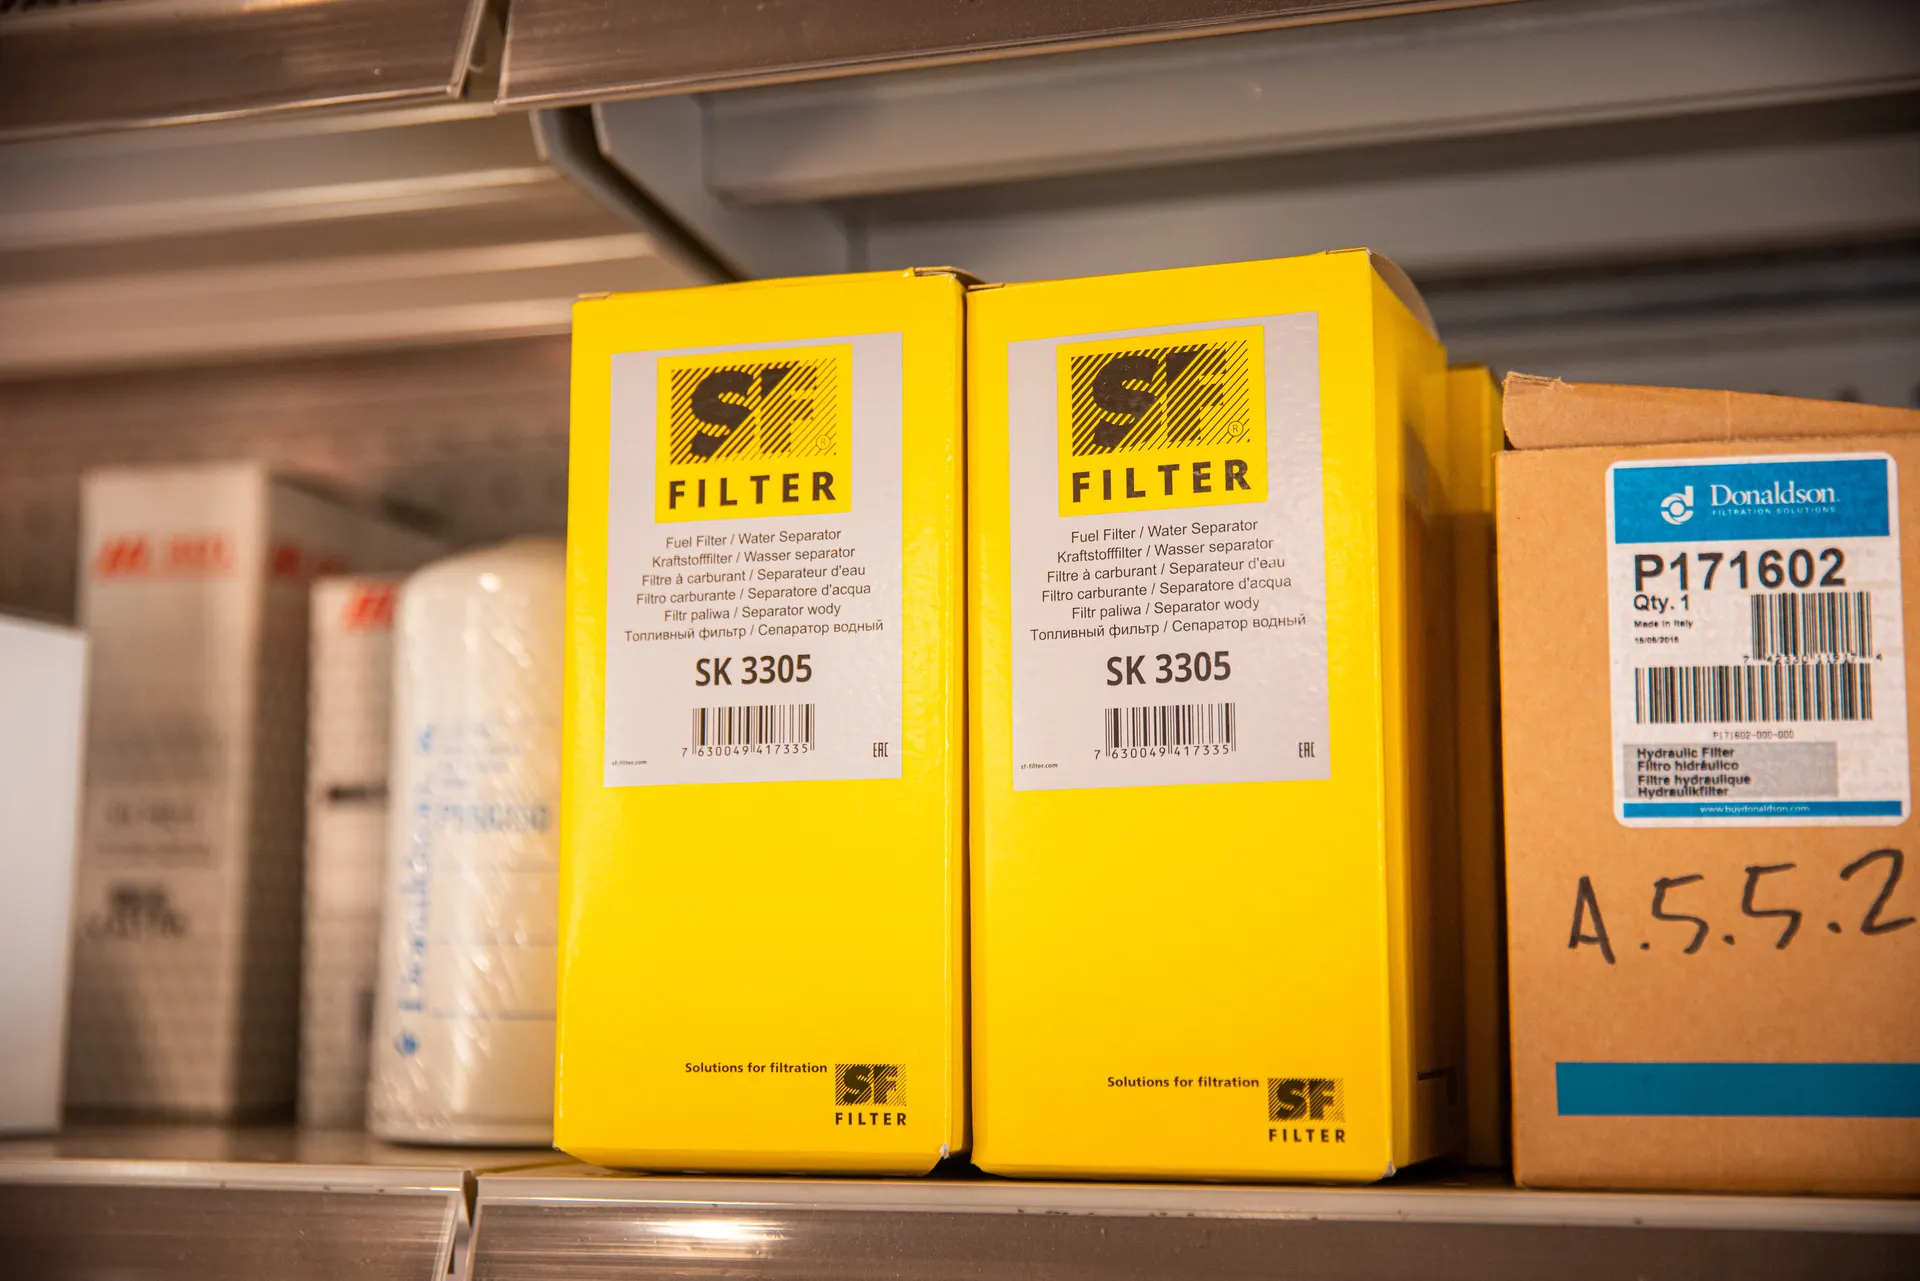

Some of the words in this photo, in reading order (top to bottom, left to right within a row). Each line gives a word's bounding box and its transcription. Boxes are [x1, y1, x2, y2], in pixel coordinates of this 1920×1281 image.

[1092, 348, 1228, 449] SF
[689, 366, 818, 459] SF
[669, 471, 836, 509] FILTER
[1072, 458, 1251, 503] FILTER
[1710, 481, 1835, 506] Donaldson
[1712, 508, 1771, 516] FILTRATION
[1777, 506, 1836, 515] SOLUTIONS
[666, 536, 693, 548] Fuel
[696, 534, 726, 547] Filter
[739, 531, 776, 544] Water
[779, 528, 841, 545] Separator
[1071, 529, 1099, 543] Fuel
[1103, 527, 1136, 541] Filter
[1148, 523, 1187, 538] Water
[1191, 519, 1259, 537] Separator
[652, 552, 733, 567] Kraftstofffilter
[744, 549, 791, 562] Wasser
[795, 546, 855, 563] separator
[1057, 547, 1143, 563] Kraftstofffilter
[1155, 542, 1205, 556] Wasser
[1209, 538, 1273, 556] separator
[642, 573, 672, 586] Filtre
[676, 572, 683, 585] à
[687, 570, 746, 584] carburant
[757, 566, 828, 582] Separateur
[831, 564, 865, 577] d'eau
[1047, 569, 1078, 581] Filtre
[1082, 568, 1091, 580] à
[1094, 564, 1158, 579] carburant
[1169, 559, 1244, 577] Separateur
[1248, 557, 1285, 570] d'eau
[1634, 548, 1846, 592] P171602
[636, 591, 666, 605] Filtro
[670, 588, 736, 603] carburante
[748, 586, 818, 602] Separatore
[821, 583, 871, 599] d'acqua
[1042, 589, 1073, 602] Filtro
[1077, 585, 1148, 600] carburante
[1160, 579, 1234, 598] Separatore
[1238, 577, 1292, 594] d'acqua
[664, 609, 687, 621] Filtr
[690, 607, 730, 624] paliwa
[742, 604, 803, 621] Separator
[806, 603, 841, 618] wody
[1072, 607, 1097, 620] Filtr
[1100, 603, 1143, 622] paliwa
[1154, 599, 1221, 618] Separator
[1224, 597, 1260, 614] wody
[1634, 595, 1675, 614] Qty.
[1680, 594, 1689, 610] 1
[624, 626, 695, 642] Топливный
[699, 625, 746, 643] фильтр
[758, 622, 830, 639] Сепаратор
[833, 620, 884, 635] водный
[1030, 625, 1105, 642] Топливный
[1109, 622, 1160, 643] фильтр
[1172, 618, 1249, 637] Сепаратор
[1253, 614, 1306, 631] водный
[1634, 620, 1659, 628] Made
[1674, 619, 1693, 629] Italy
[695, 658, 732, 686] SK
[742, 655, 812, 684] 3305
[1107, 655, 1146, 686] SK
[1156, 651, 1231, 684] 3305
[682, 748, 688, 757] 7
[698, 746, 748, 756] 630049
[756, 744, 808, 754] 417335
[1094, 750, 1100, 760] 7
[1112, 747, 1165, 759] 630049
[1174, 745, 1228, 756] 417335
[1637, 749, 1698, 761] Hydraulic
[1702, 748, 1735, 757] Filter
[1021, 762, 1058, 770] sf-filter.com
[1638, 761, 1671, 771] Filtro
[1675, 760, 1739, 771] hidráulico
[1638, 775, 1671, 785] Filtre
[1674, 774, 1751, 786] hydraulique
[1638, 787, 1728, 798] Hydraulikfilter
[1700, 805, 1810, 813] www.buydonaldson.com
[685, 1063, 743, 1073] Solutions
[747, 1062, 766, 1073] for
[770, 1062, 828, 1073] filtration
[843, 1066, 898, 1104] SF
[1107, 1077, 1170, 1088] Solutions
[1174, 1076, 1193, 1088] for
[1198, 1076, 1259, 1088] filtration
[1276, 1080, 1335, 1120] SF
[835, 1112, 906, 1125] FILTER
[1269, 1128, 1346, 1142] FILTER
